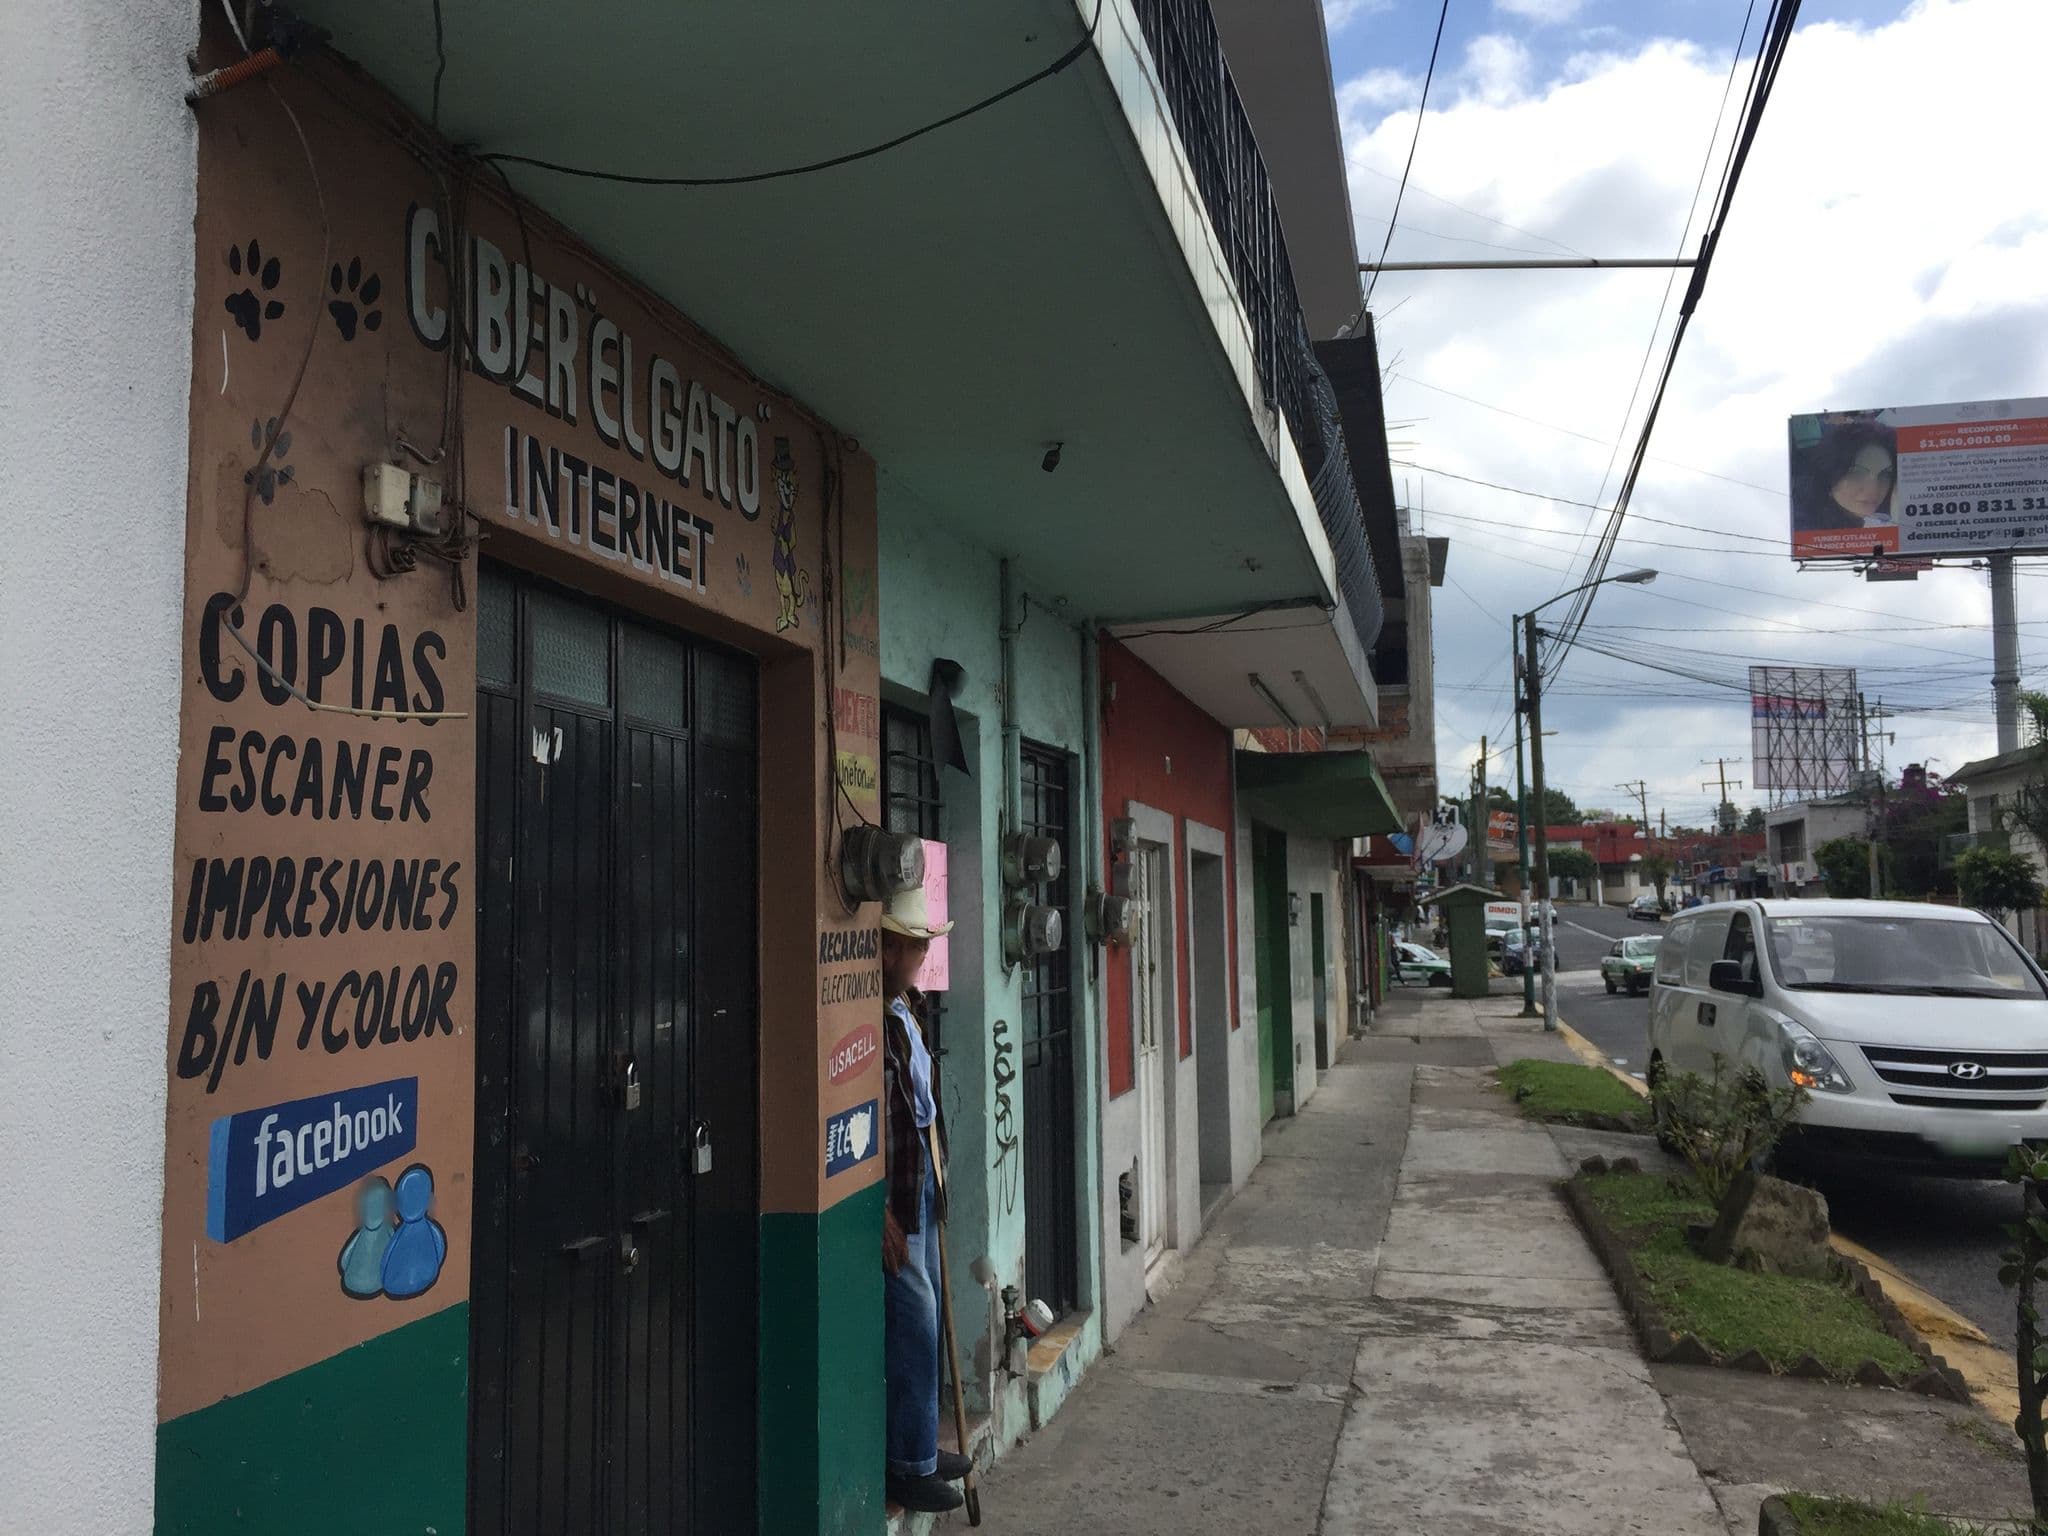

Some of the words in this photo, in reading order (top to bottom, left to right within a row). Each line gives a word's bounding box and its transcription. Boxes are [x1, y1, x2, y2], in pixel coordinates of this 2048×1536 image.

[503, 424, 714, 595] INTERNET
[1905, 501, 1971, 517] 01800
[1977, 499, 2017, 513] 831
[1939, 483, 1981, 491] DENUNCIA
[199, 592, 446, 726] COPIAS
[199, 726, 433, 823] ESCANER
[183, 856, 461, 944] IMPRESIONES
[1488, 905, 1518, 915] BIMBO
[819, 928, 879, 965] RECARGAS
[821, 969, 881, 1006] ELECTRONICAS
[176, 968, 286, 1094] B/N
[322, 961, 458, 1054] COLOR
[828, 1032, 876, 1081] IUSACELL
[254, 1093, 403, 1198] facebook
